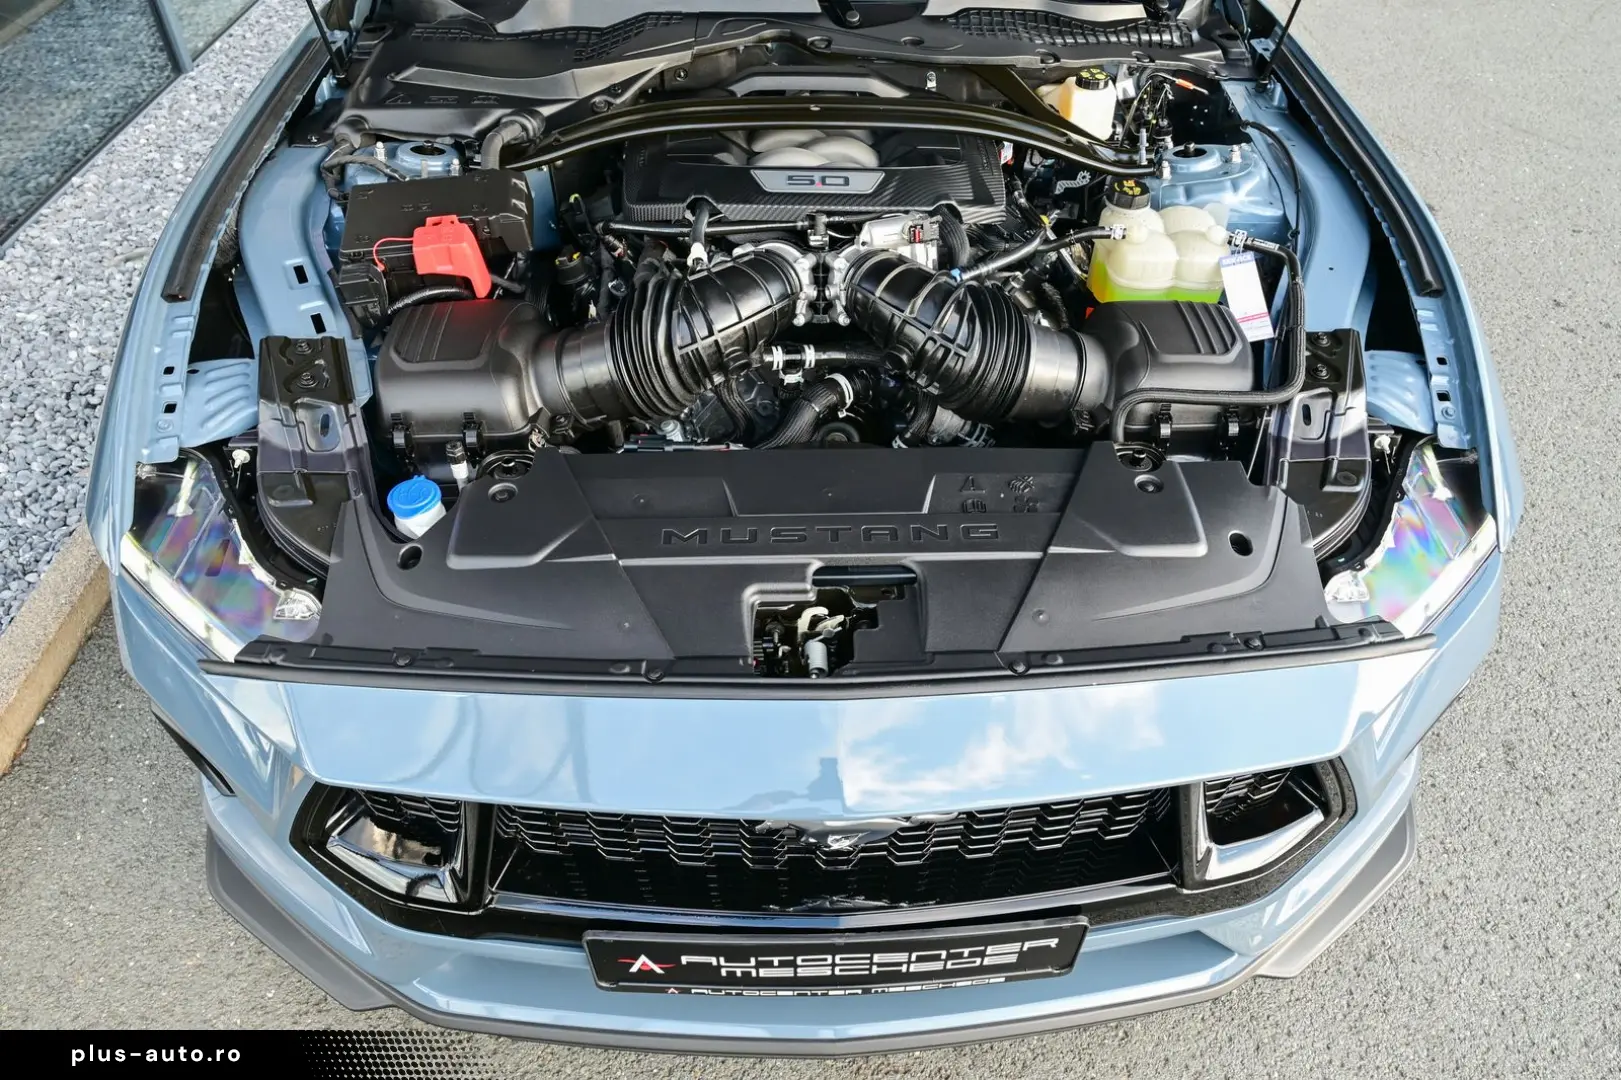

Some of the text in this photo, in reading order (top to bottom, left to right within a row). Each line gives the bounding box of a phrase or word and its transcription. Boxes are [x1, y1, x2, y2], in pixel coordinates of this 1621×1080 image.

[787, 174, 850, 188] 5.0
[661, 523, 999, 545] MUSTANG
[680, 937, 1060, 967] AUTOCENTER
[720, 953, 1019, 978] MESCHEDE
